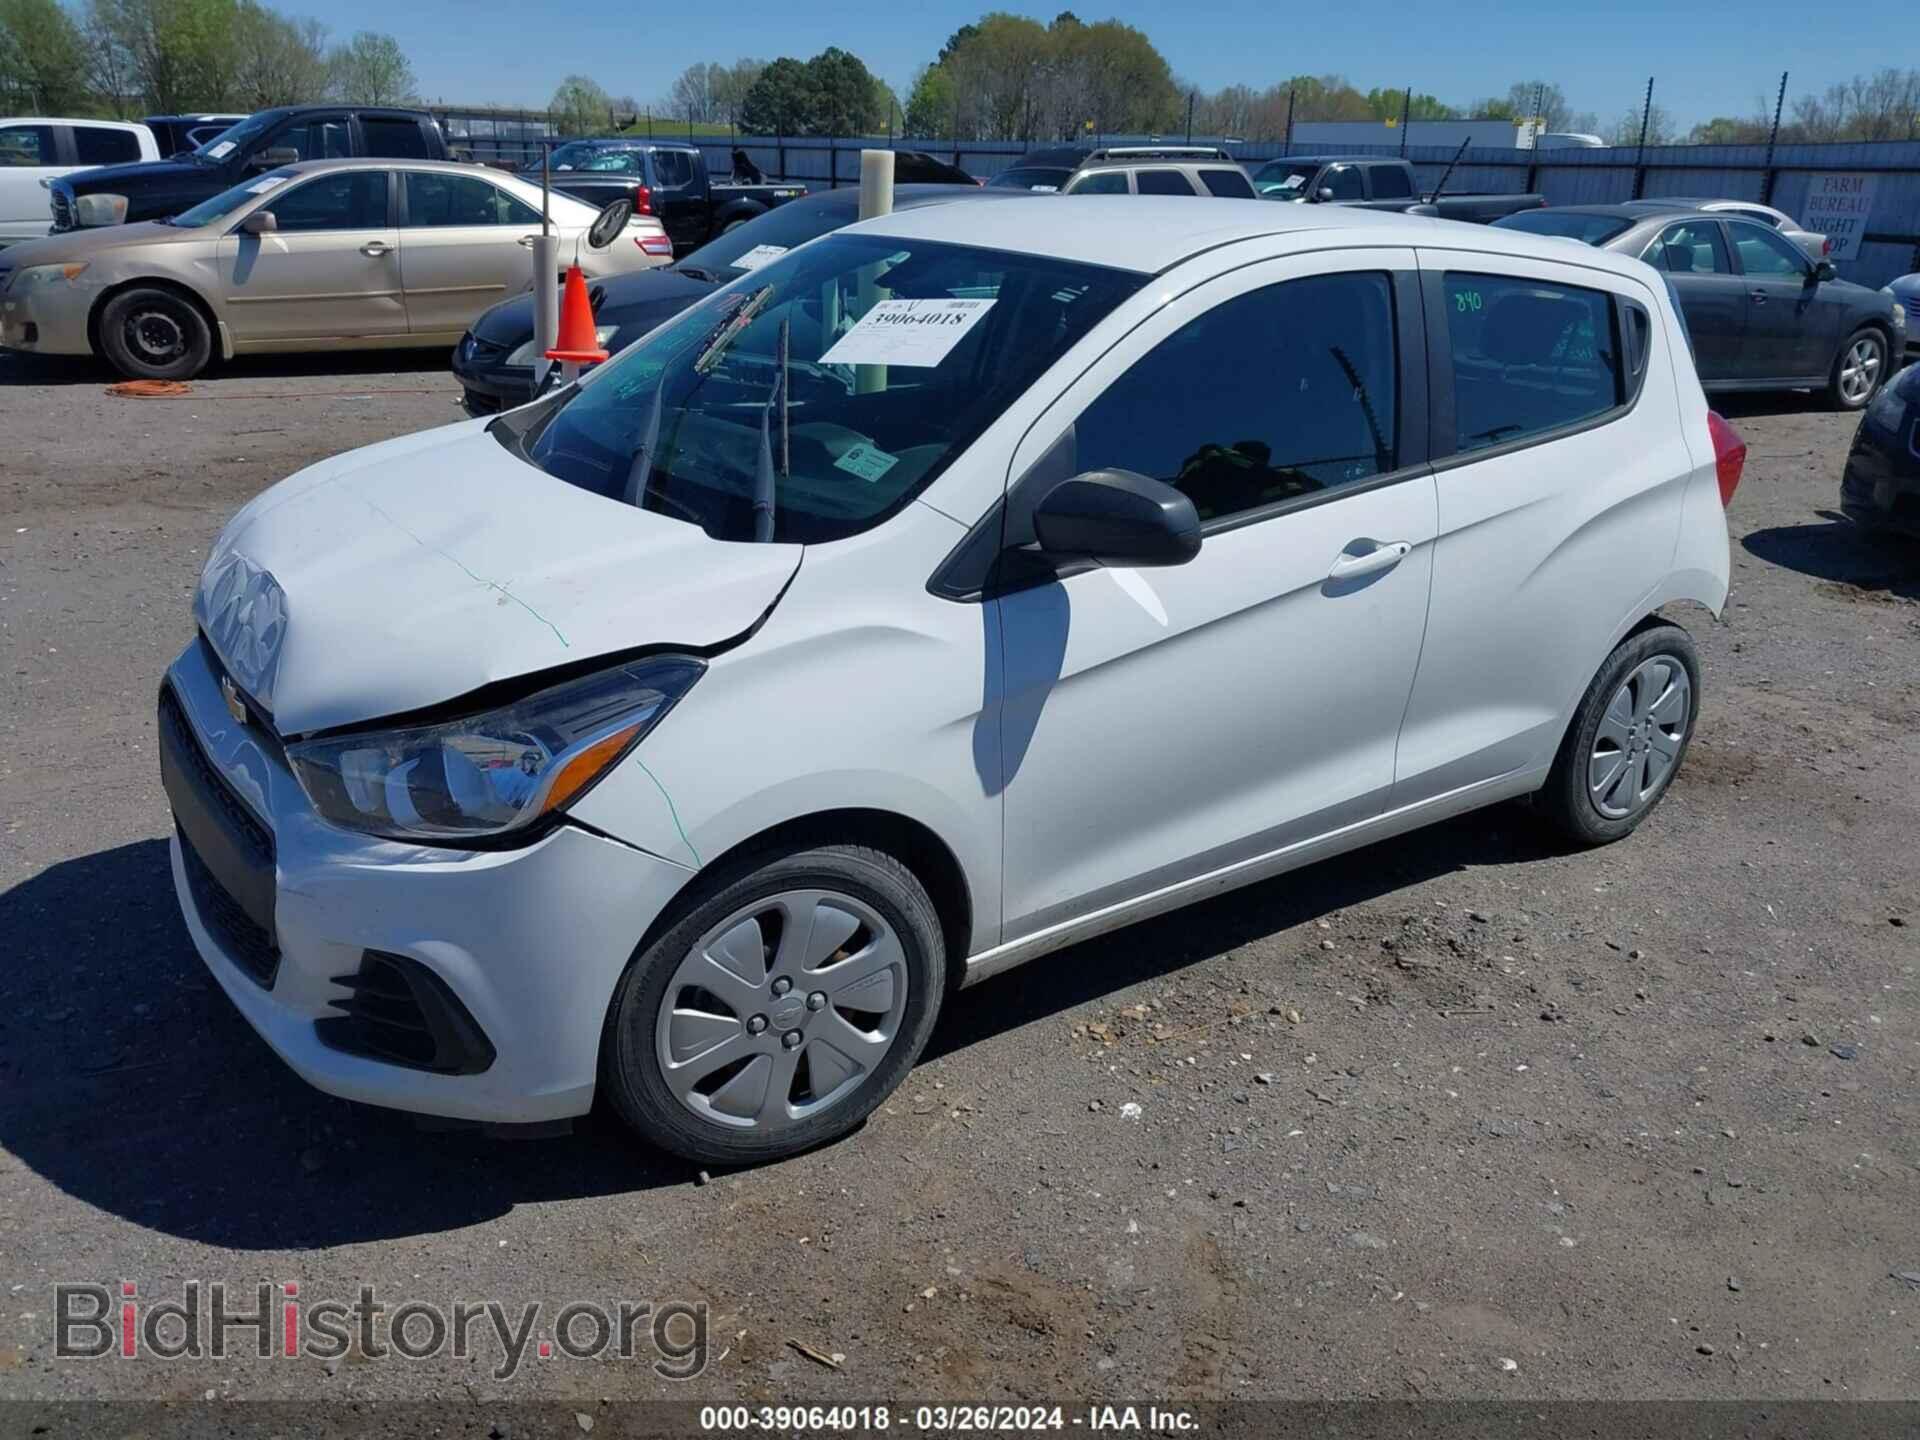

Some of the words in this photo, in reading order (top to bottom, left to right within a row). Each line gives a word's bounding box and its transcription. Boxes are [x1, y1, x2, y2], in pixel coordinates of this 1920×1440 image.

[1823, 176, 1864, 193] FARM
[1808, 195, 1871, 213] BUREAU
[1809, 217, 1857, 233] NIGHT
